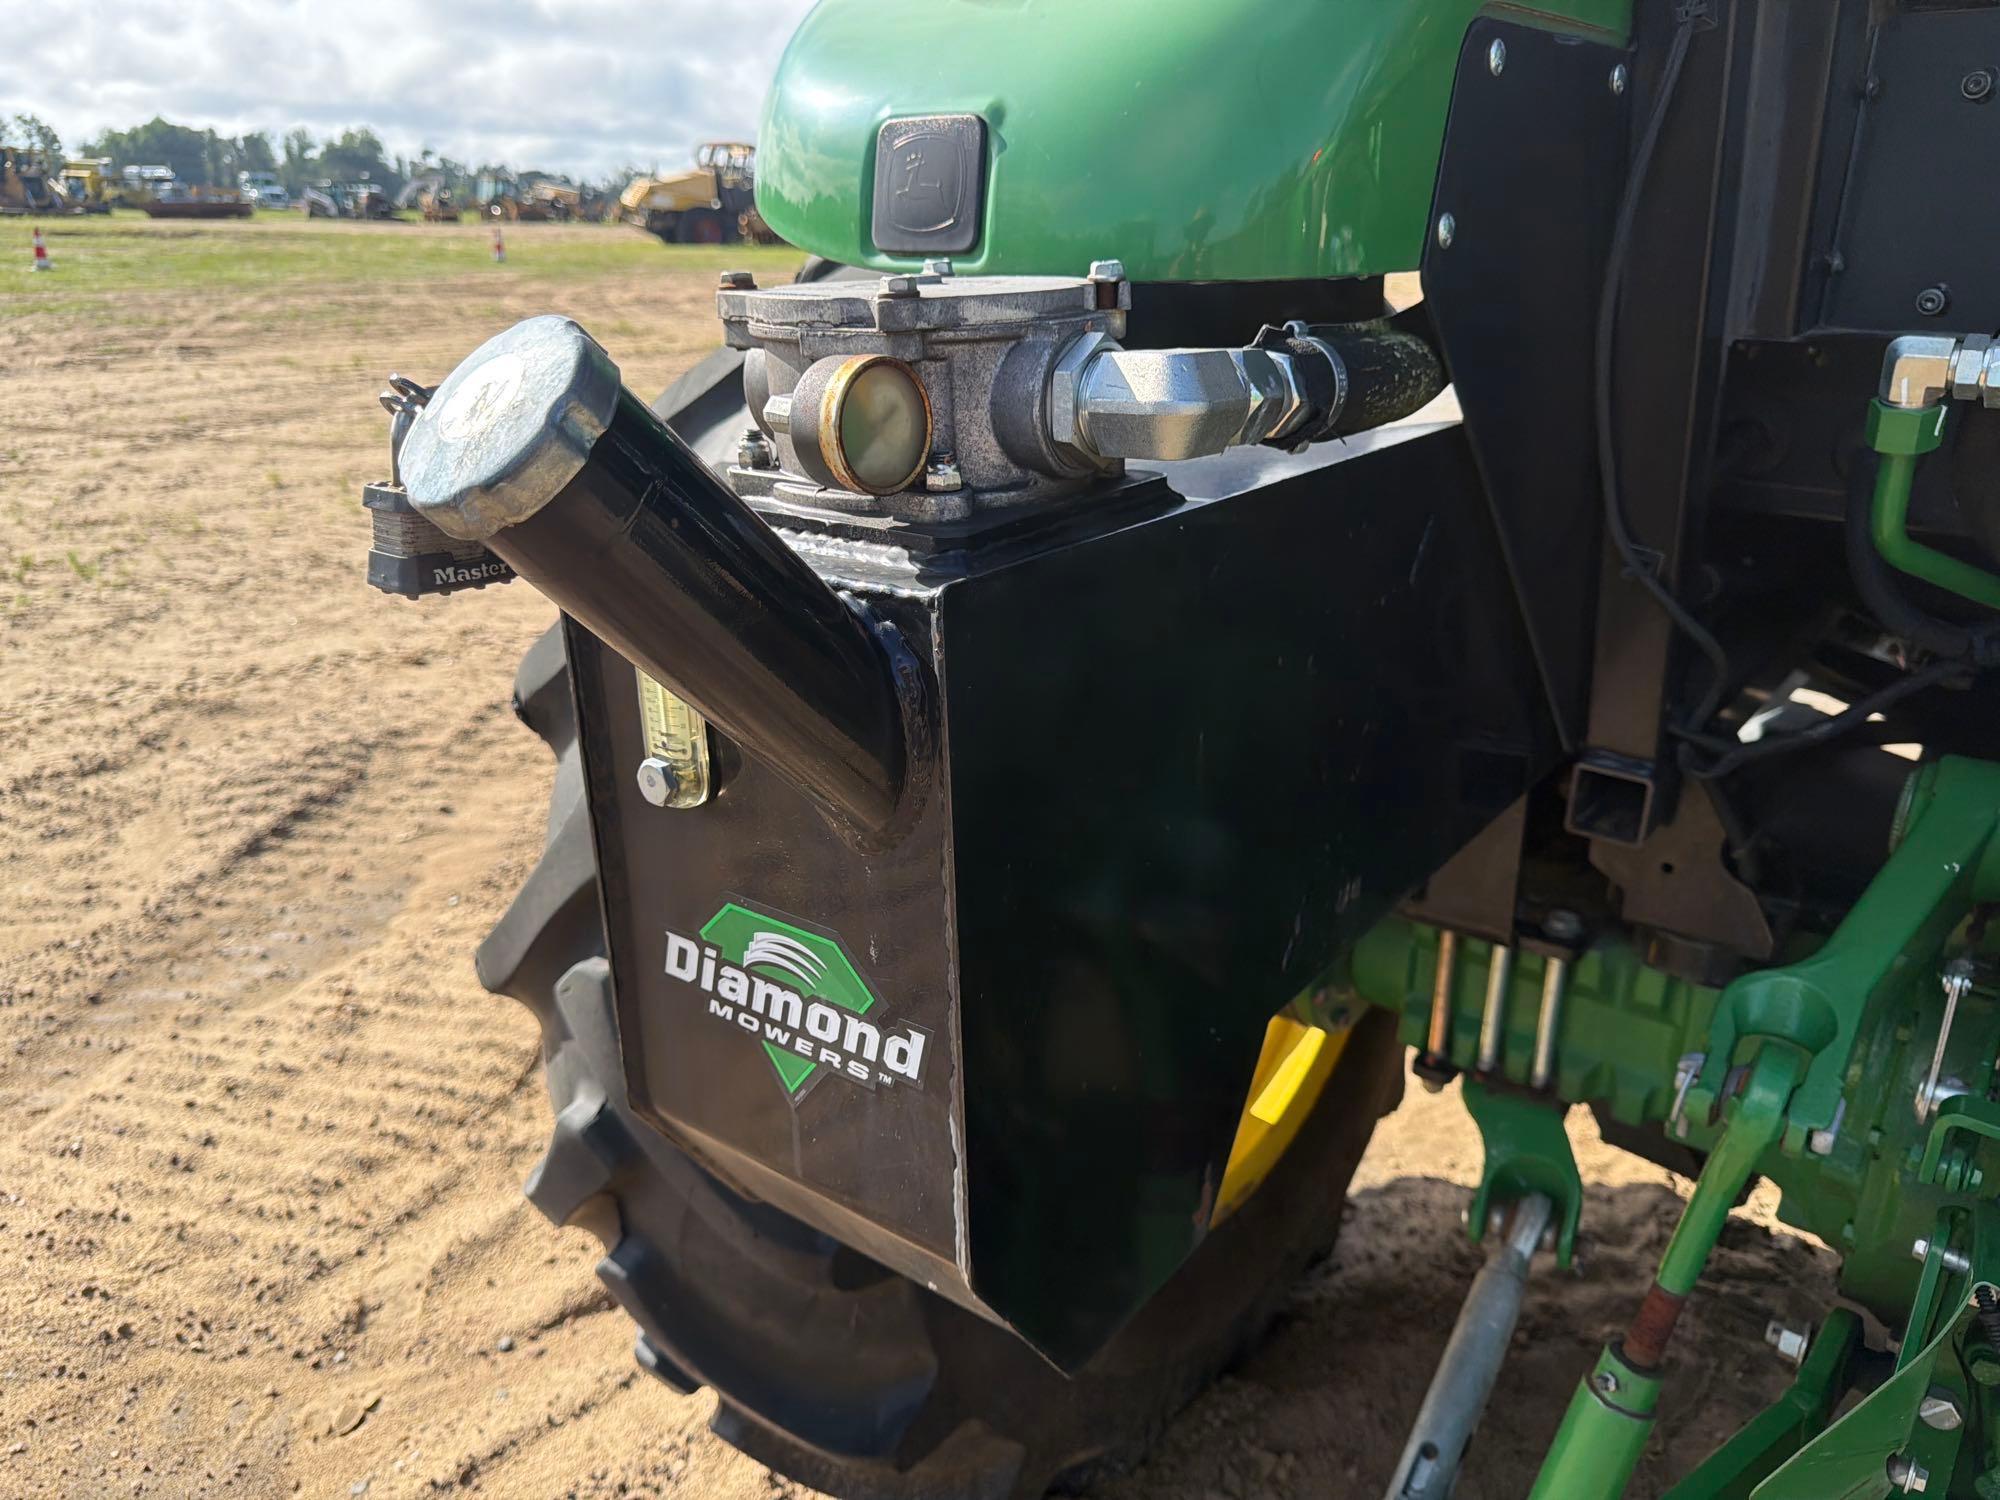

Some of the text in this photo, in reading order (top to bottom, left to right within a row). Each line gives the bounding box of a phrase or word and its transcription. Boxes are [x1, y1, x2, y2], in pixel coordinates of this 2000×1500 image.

[433, 563, 509, 585] Master
[665, 930, 926, 1080] Diamond
[708, 999, 870, 1080] MOWERS
